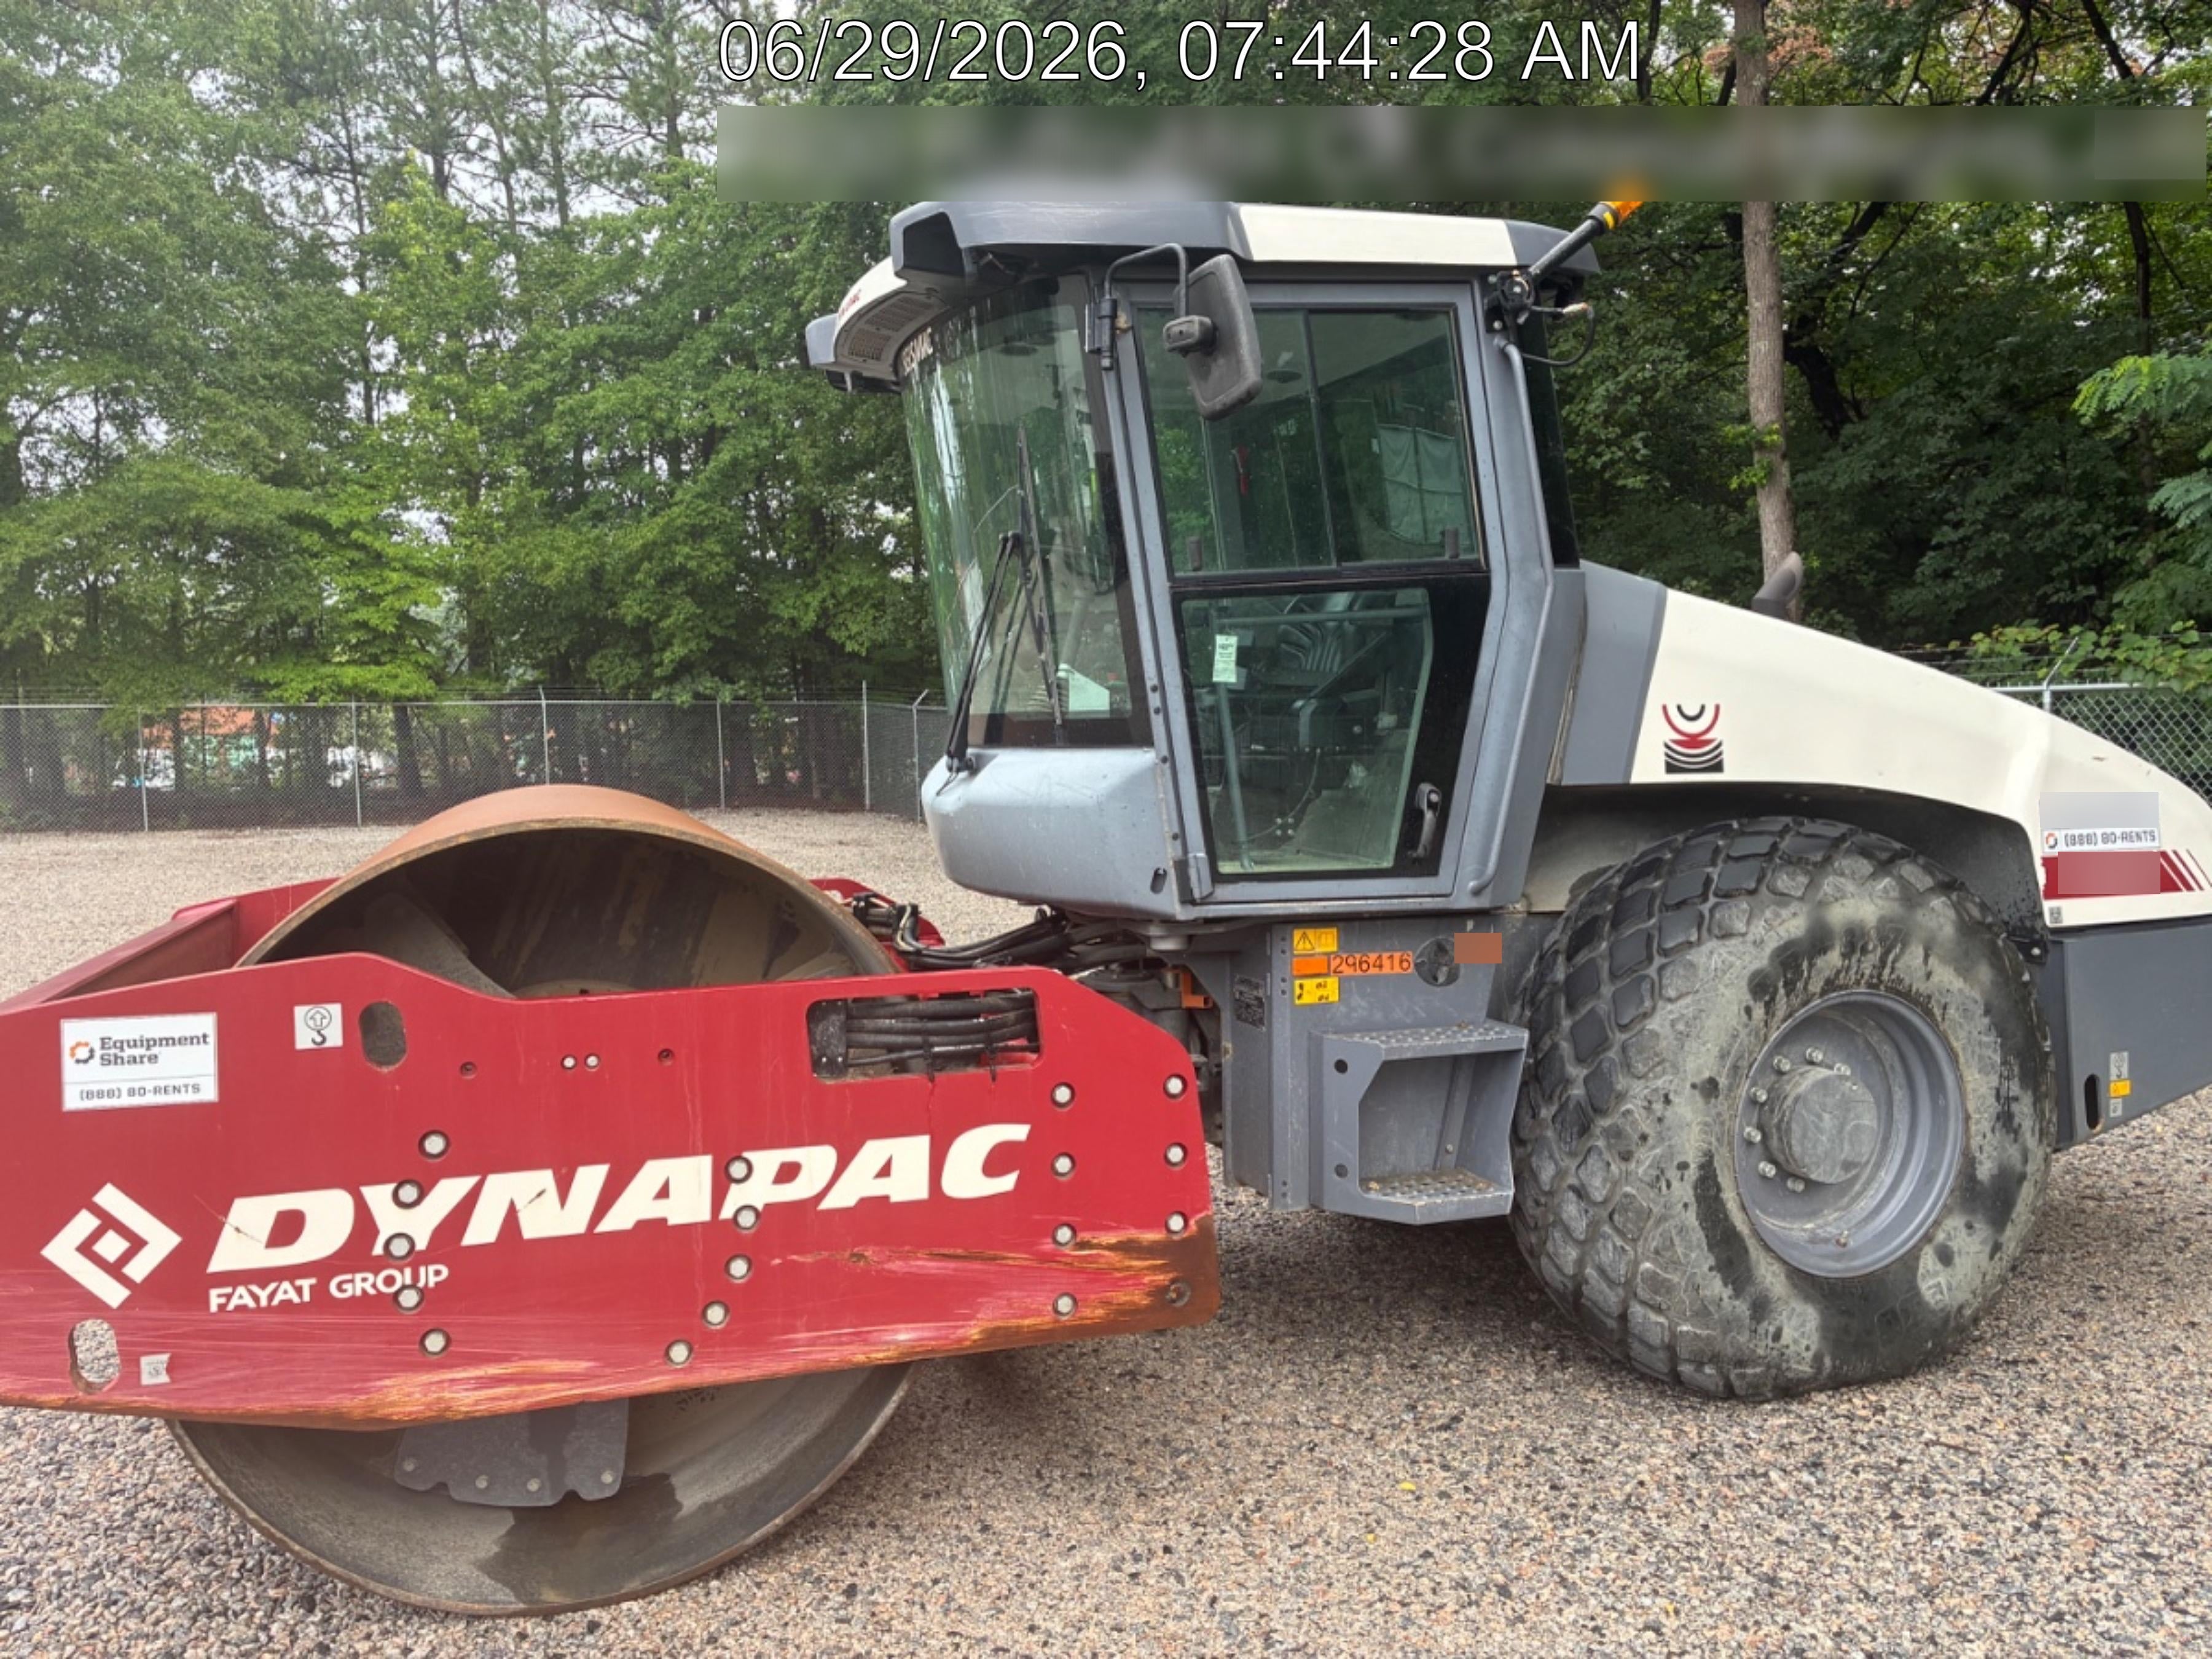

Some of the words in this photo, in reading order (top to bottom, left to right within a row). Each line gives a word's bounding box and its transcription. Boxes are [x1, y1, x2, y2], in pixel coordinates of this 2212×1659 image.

[2065, 832, 2097, 847] (888)
[2101, 830, 2155, 844] 80-RENTS
[1332, 954, 1411, 973] 296416
[100, 1033, 210, 1051] Equipment
[100, 1052, 159, 1066] Share
[80, 1087, 122, 1100] (888)
[127, 1083, 201, 1097] 80-RENTS
[206, 1124, 1030, 1274] DYNAPAC
[209, 1277, 317, 1313] FAYAT
[329, 1264, 449, 1299] GROUP
